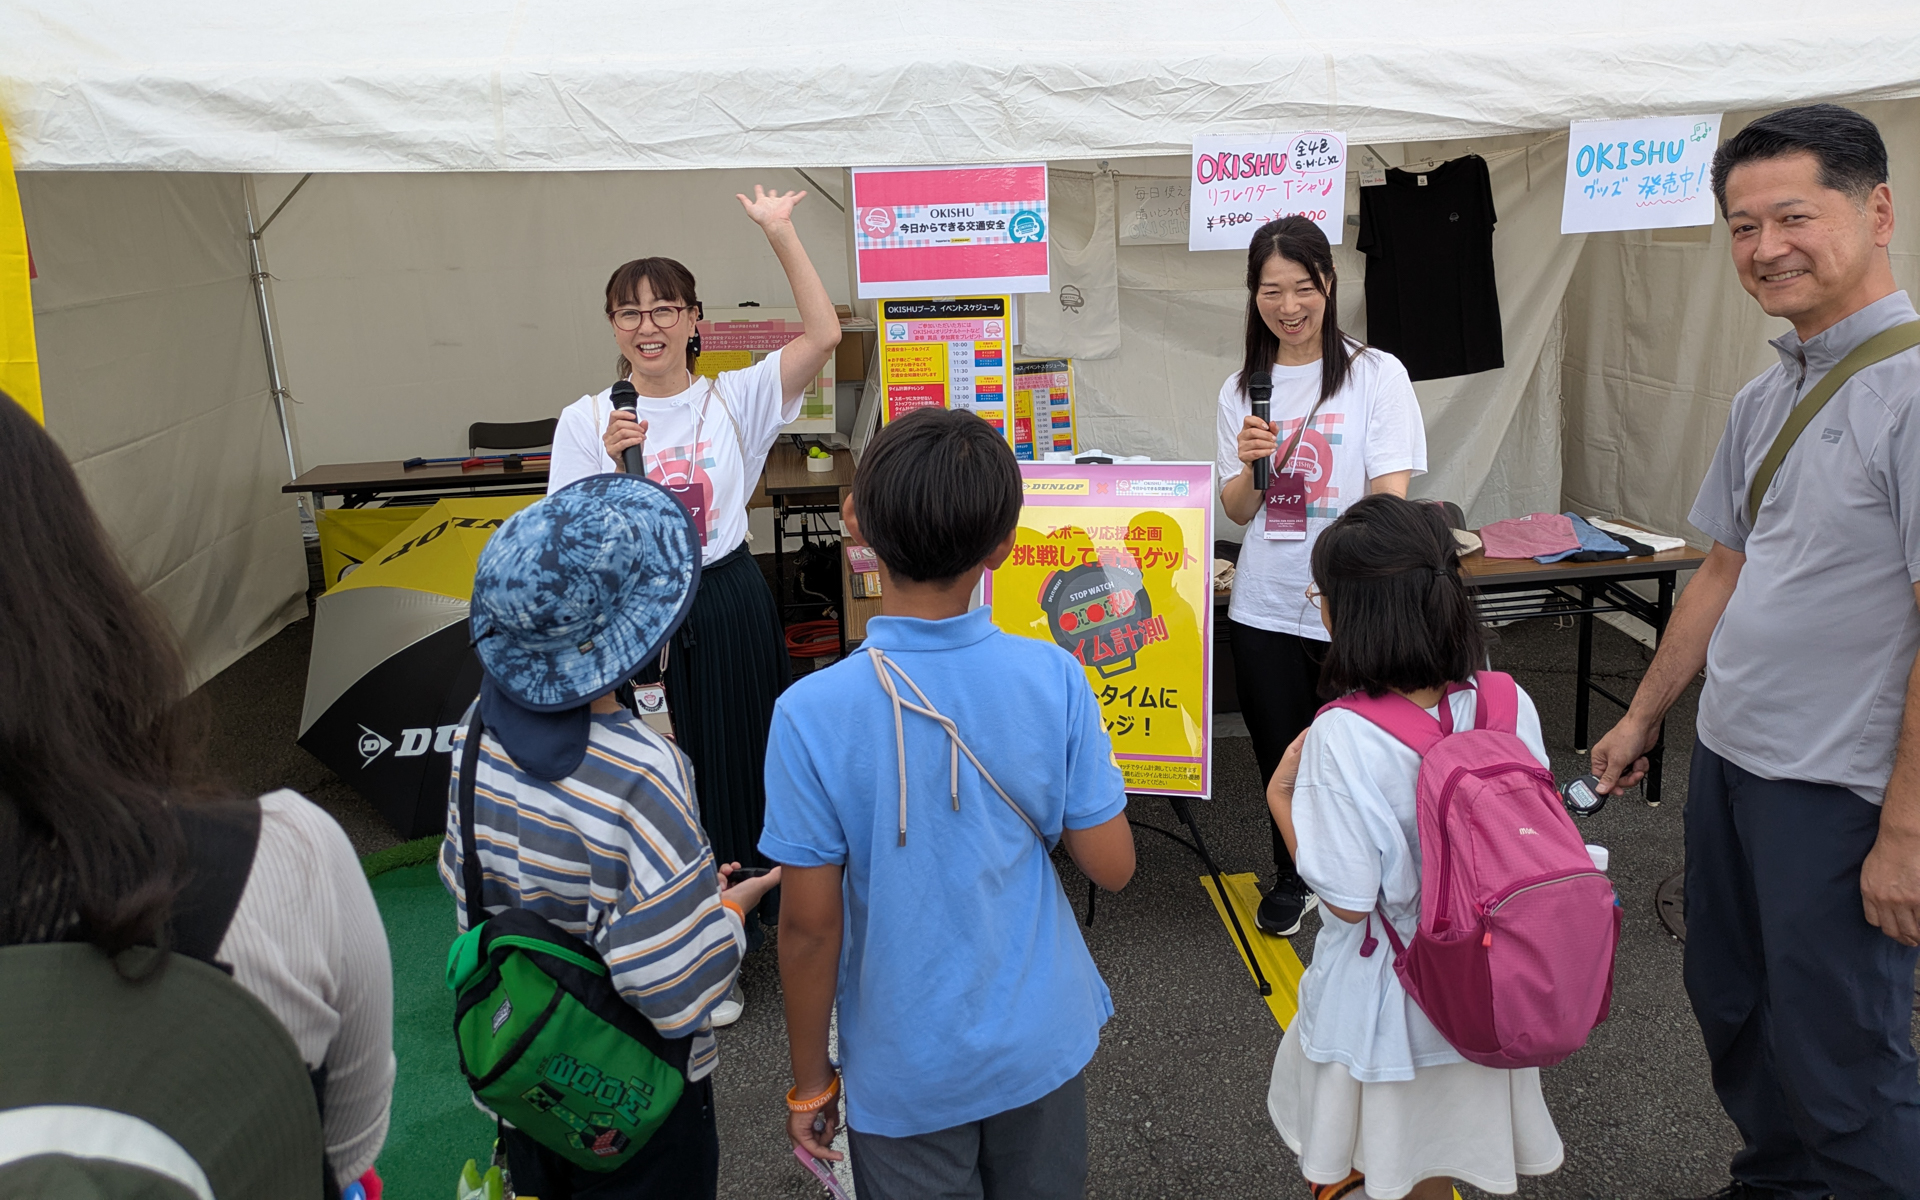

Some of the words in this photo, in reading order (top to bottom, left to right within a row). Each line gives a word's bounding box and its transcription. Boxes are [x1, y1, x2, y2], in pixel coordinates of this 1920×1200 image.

[1295, 138, 1330, 157] 全4色
[1576, 139, 1685, 178] OKISHU
[1197, 152, 1288, 185] OKISHU
[1208, 184, 1277, 206] リフレクター
[1584, 177, 1629, 200] グッズ
[930, 207, 975, 219] OKISHU
[900, 220, 1006, 235] 今日からできる交通安全
[887, 305, 937, 313] OKISHUブース
[940, 303, 1001, 312] イベントスケジュール
[1270, 494, 1301, 505] メディア
[1046, 526, 1163, 542] スポーツ応援企画
[1012, 544, 1198, 571] 挑戦して賞品ゲット
[1069, 590, 1088, 602] STOP
[1088, 581, 1115, 596] WATCH
[1107, 589, 1136, 618] 秒
[1072, 614, 1170, 666] イム計測
[1094, 684, 1178, 709] タイムに
